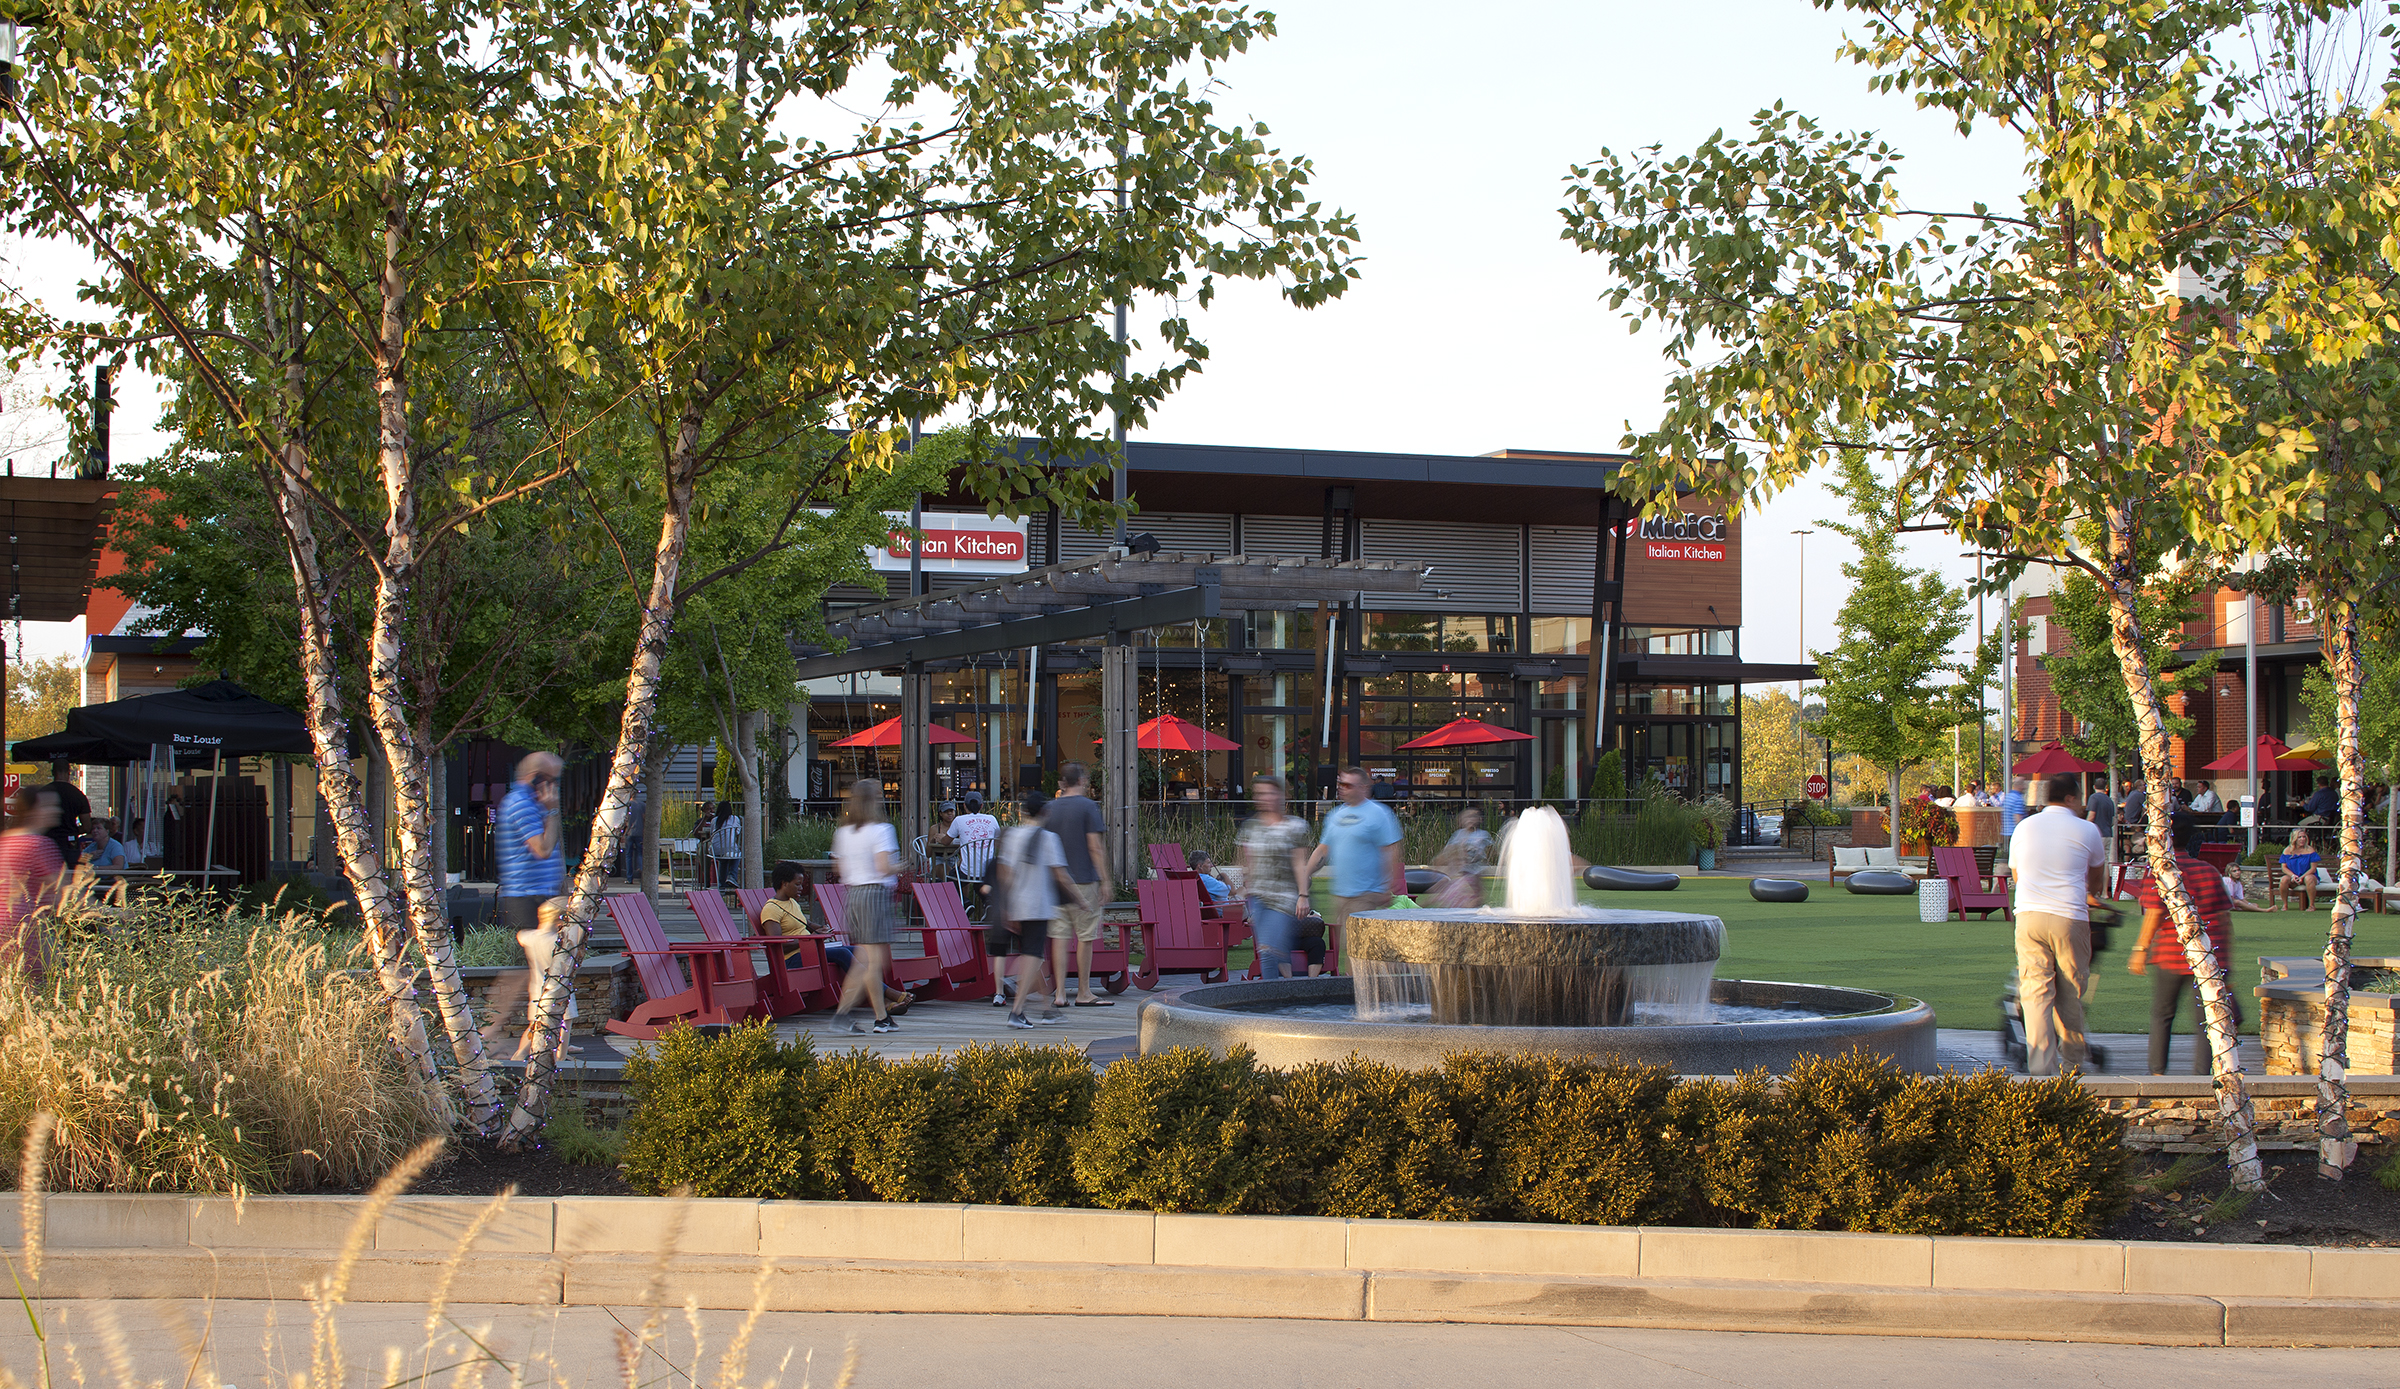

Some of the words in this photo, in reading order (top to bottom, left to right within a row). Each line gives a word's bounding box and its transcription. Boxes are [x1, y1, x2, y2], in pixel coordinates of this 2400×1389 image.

[896, 536, 948, 553] Itaian
[954, 534, 1017, 555] Kitchen
[1648, 545, 1680, 558] Italian
[1684, 546, 1722, 560] Kitchen
[173, 733, 191, 743] Bar
[193, 735, 222, 744] Louie
[1807, 782, 1826, 793] STOP
